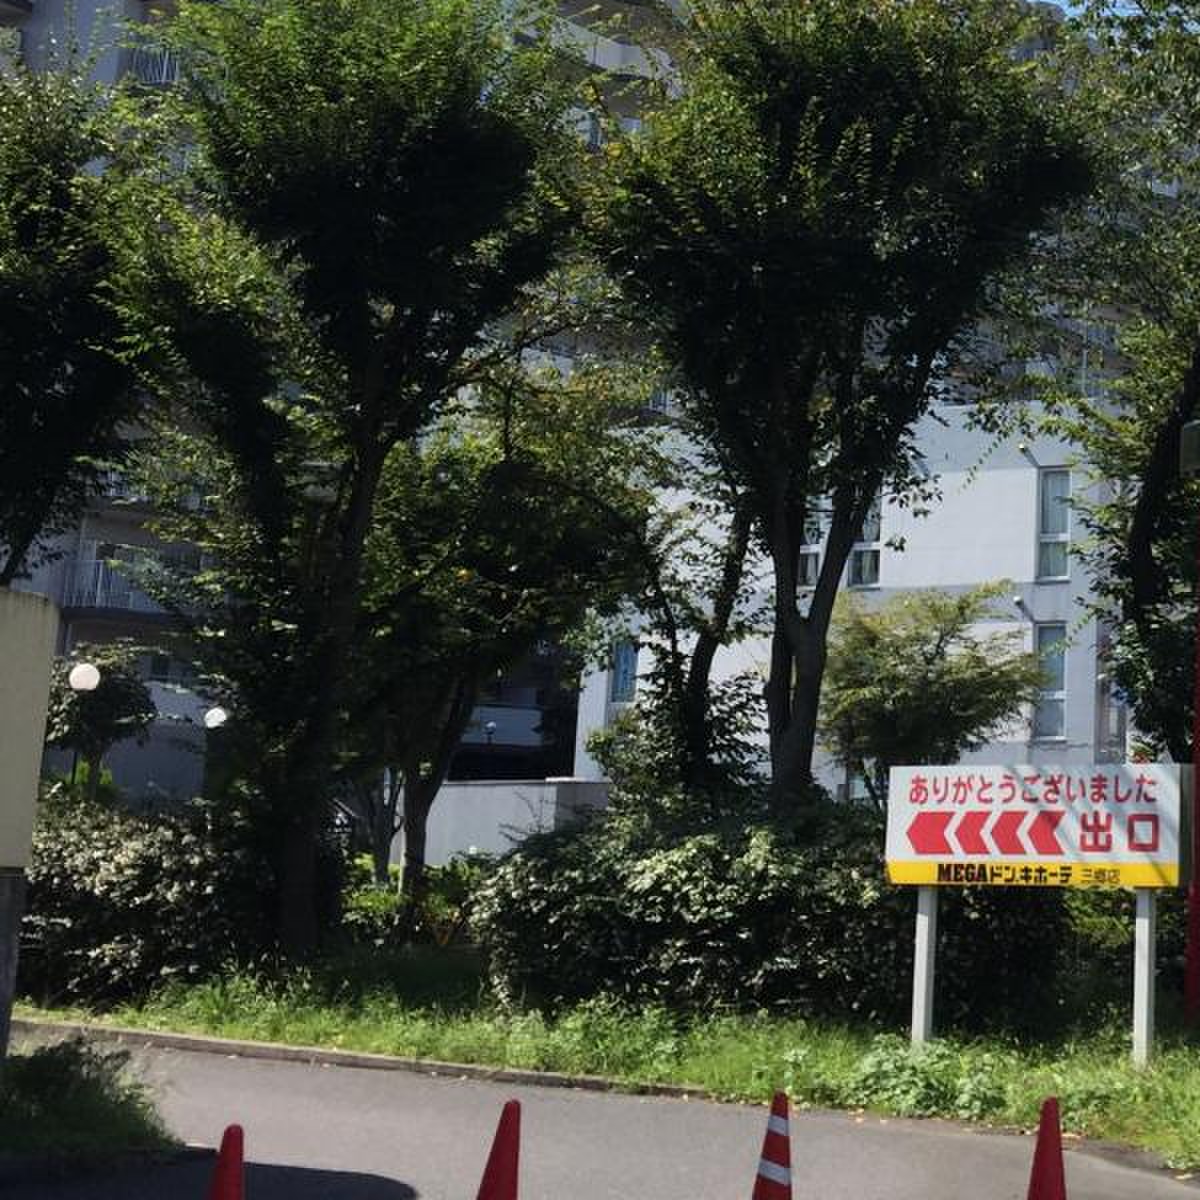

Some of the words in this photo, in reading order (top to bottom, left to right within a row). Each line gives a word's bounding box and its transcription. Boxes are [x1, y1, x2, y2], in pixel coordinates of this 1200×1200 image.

[909, 773, 1157, 805] ありがとうございました
[1080, 811, 1159, 853] 出口
